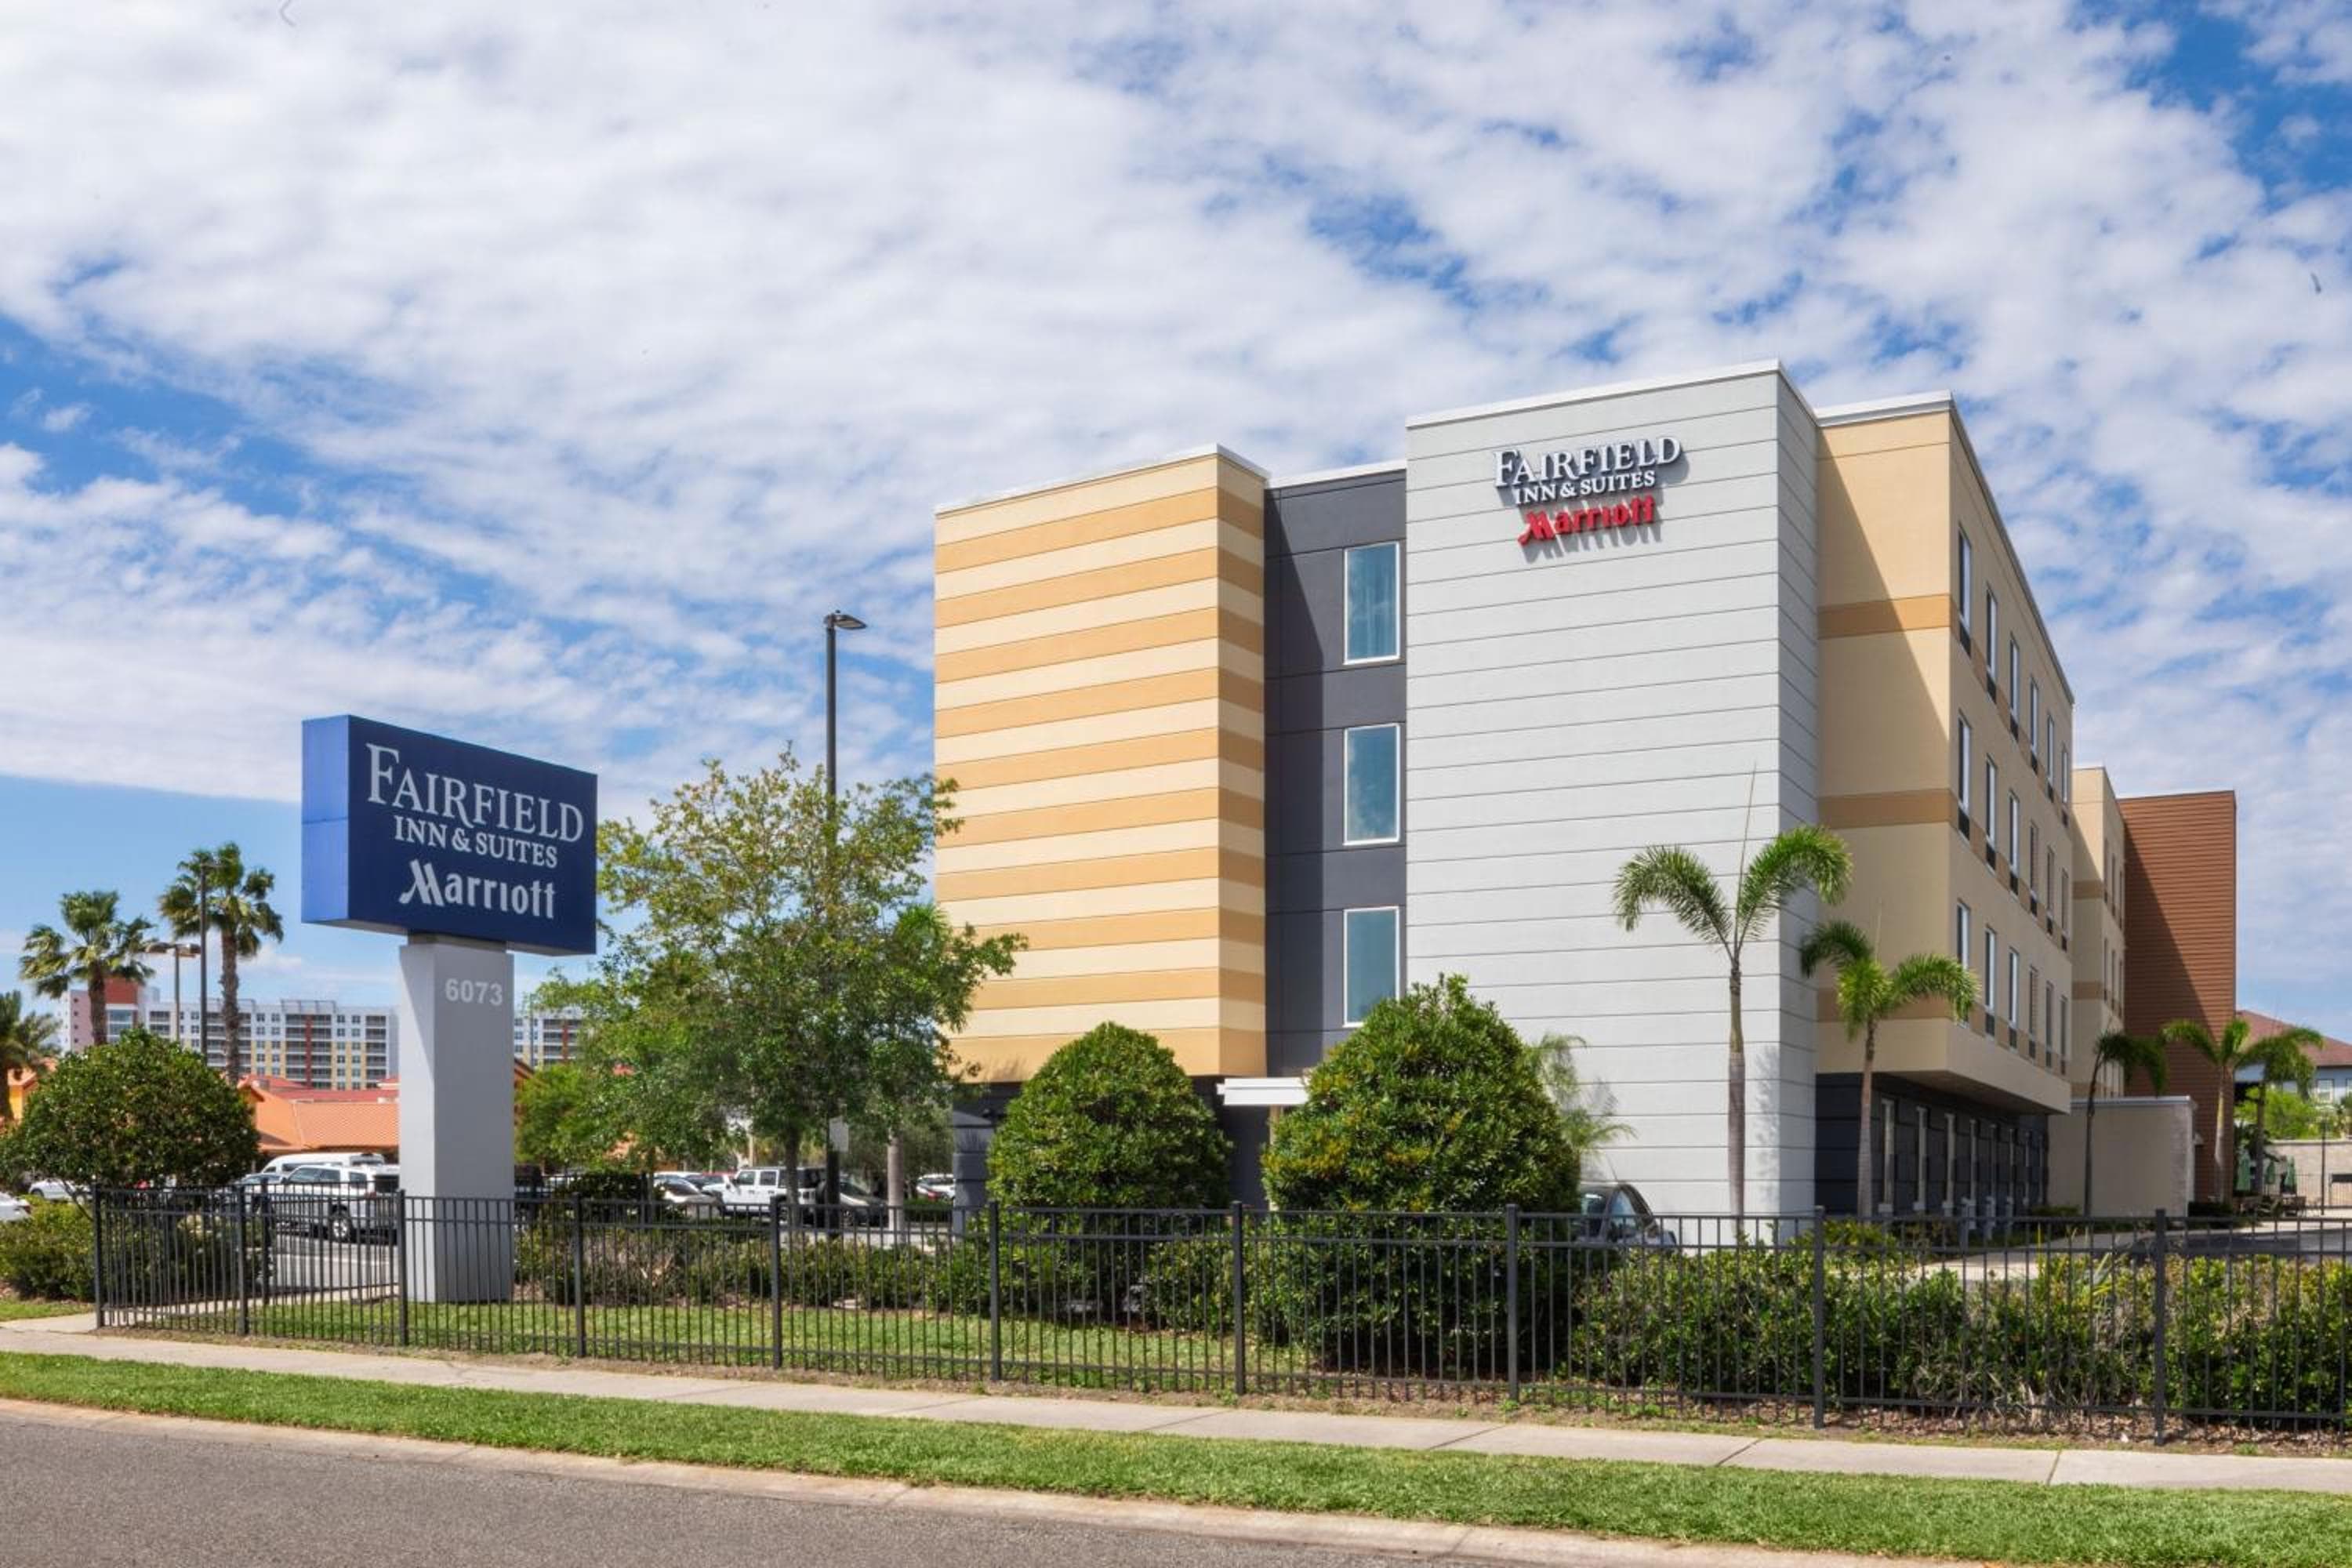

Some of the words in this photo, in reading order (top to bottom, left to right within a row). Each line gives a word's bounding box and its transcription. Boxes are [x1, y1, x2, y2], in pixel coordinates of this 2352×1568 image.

[1494, 437, 1682, 487] FAIRFIELD
[1515, 484, 1556, 504] INN
[1559, 482, 1577, 498] &
[1581, 470, 1656, 495] SUITES
[1518, 495, 1656, 546] Marriott
[366, 742, 584, 843] FAIRFIELD
[394, 815, 448, 848] INN
[452, 828, 471, 852] &
[475, 831, 557, 869] SUITES
[398, 858, 556, 919] Marriott
[445, 978, 503, 1007] 6073
